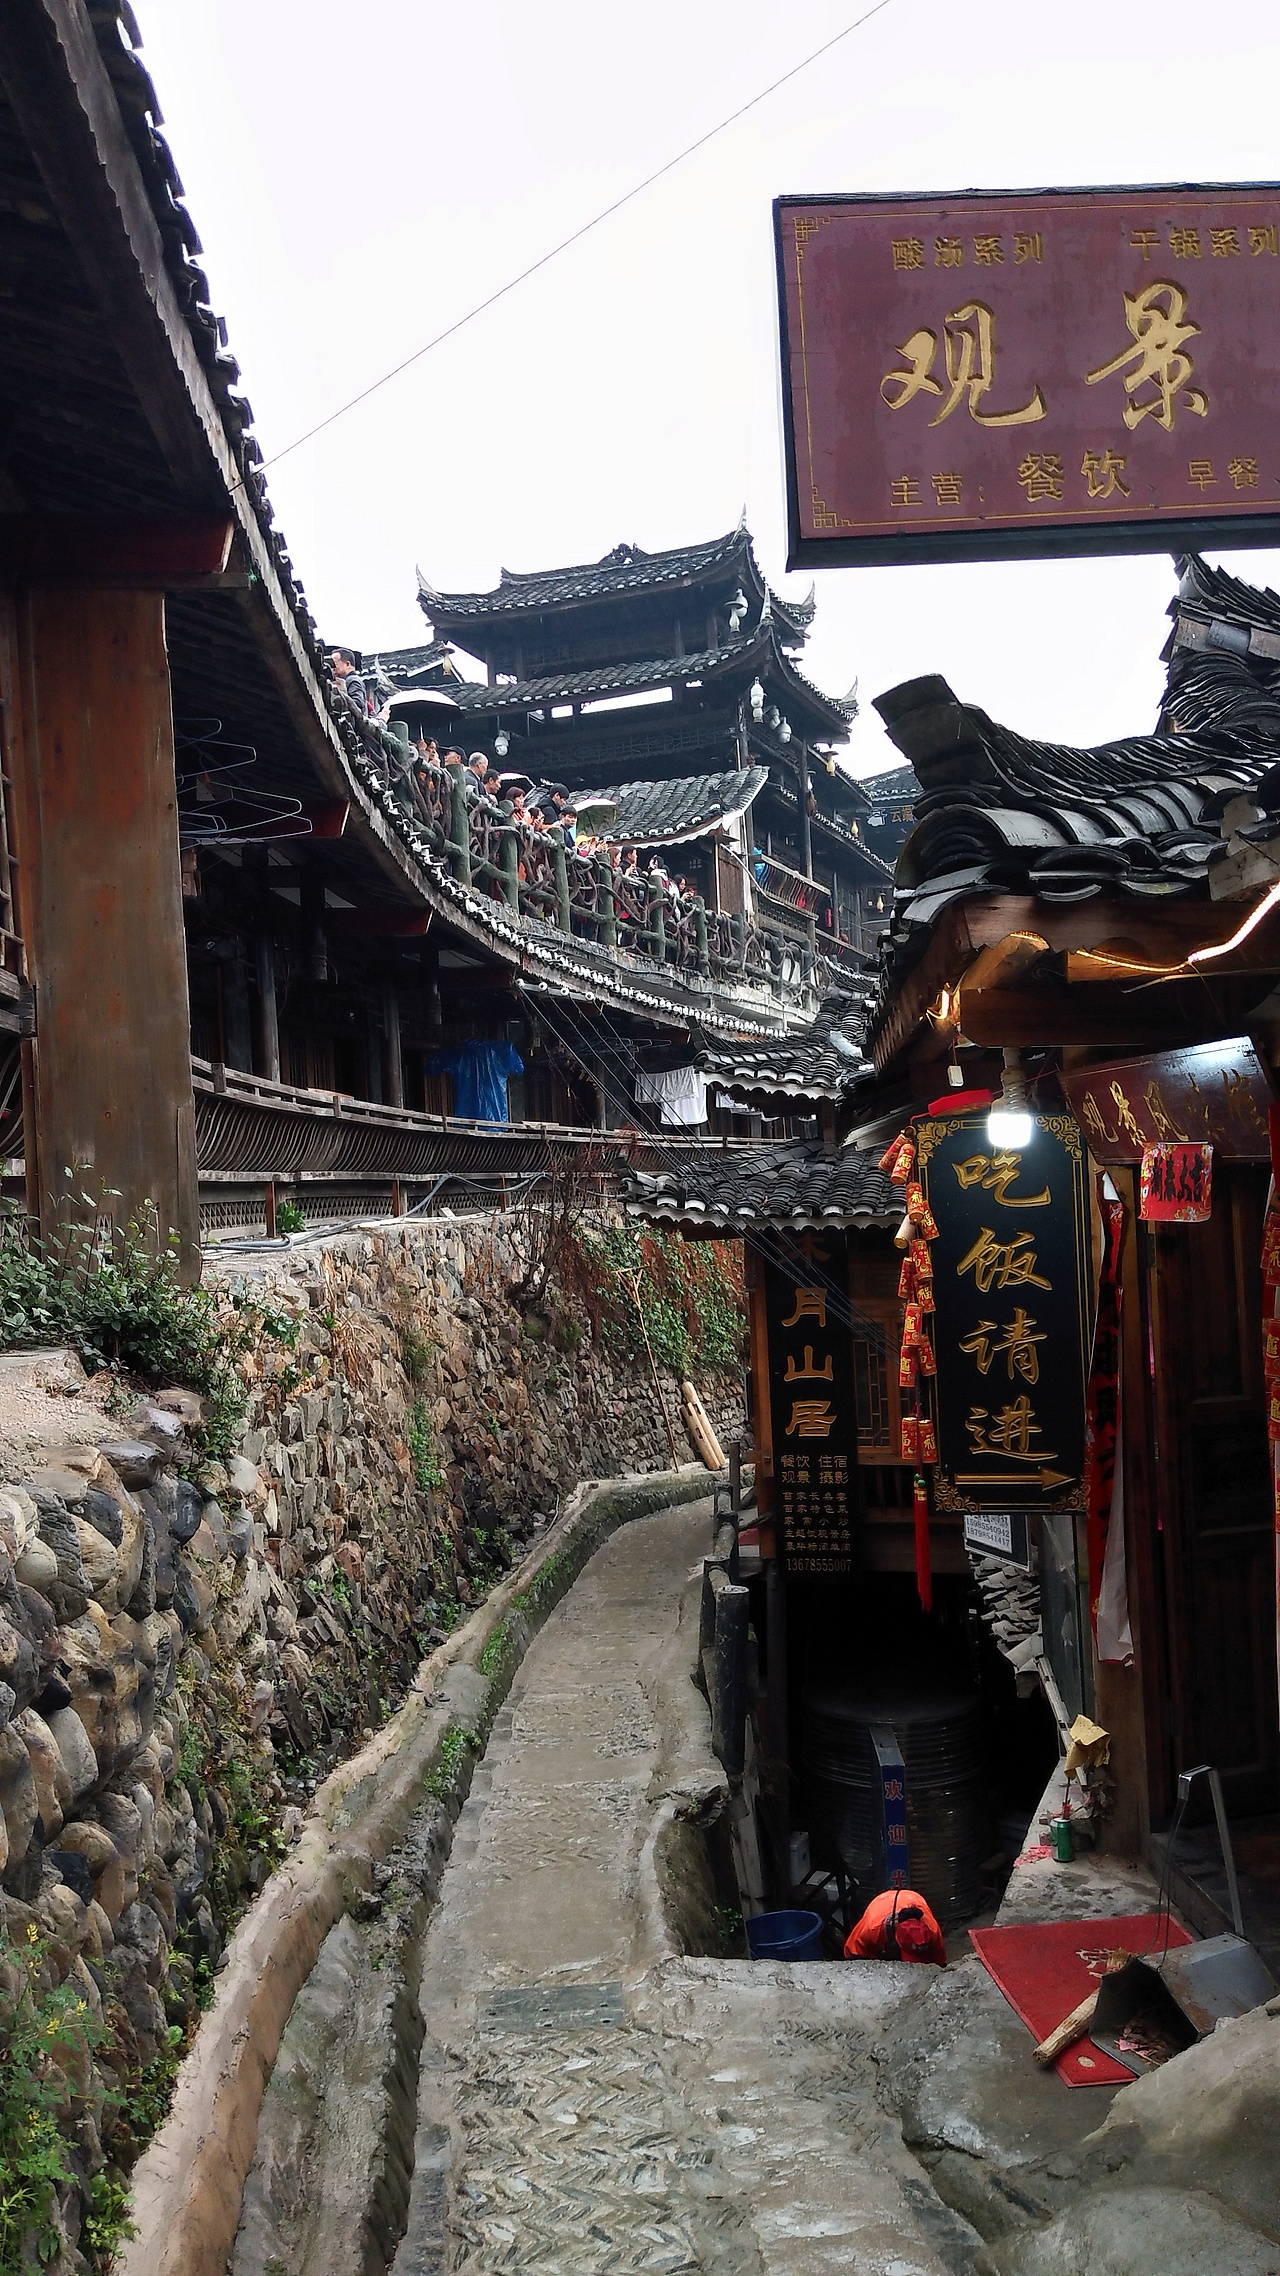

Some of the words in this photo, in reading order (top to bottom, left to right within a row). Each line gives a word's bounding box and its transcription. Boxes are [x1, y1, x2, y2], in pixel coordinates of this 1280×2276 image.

[891, 231, 1044, 270] 酸汤系列
[1130, 223, 1280, 261] 干锅系列
[951, 1146, 1059, 1461] 吃饭请进
[780, 1454, 811, 1468] 餐饮
[818, 1454, 848, 1468] 住宿
[781, 1470, 811, 1484] 观景
[819, 1471, 849, 1484] 摄影
[786, 1558, 852, 1572] 13678555007
